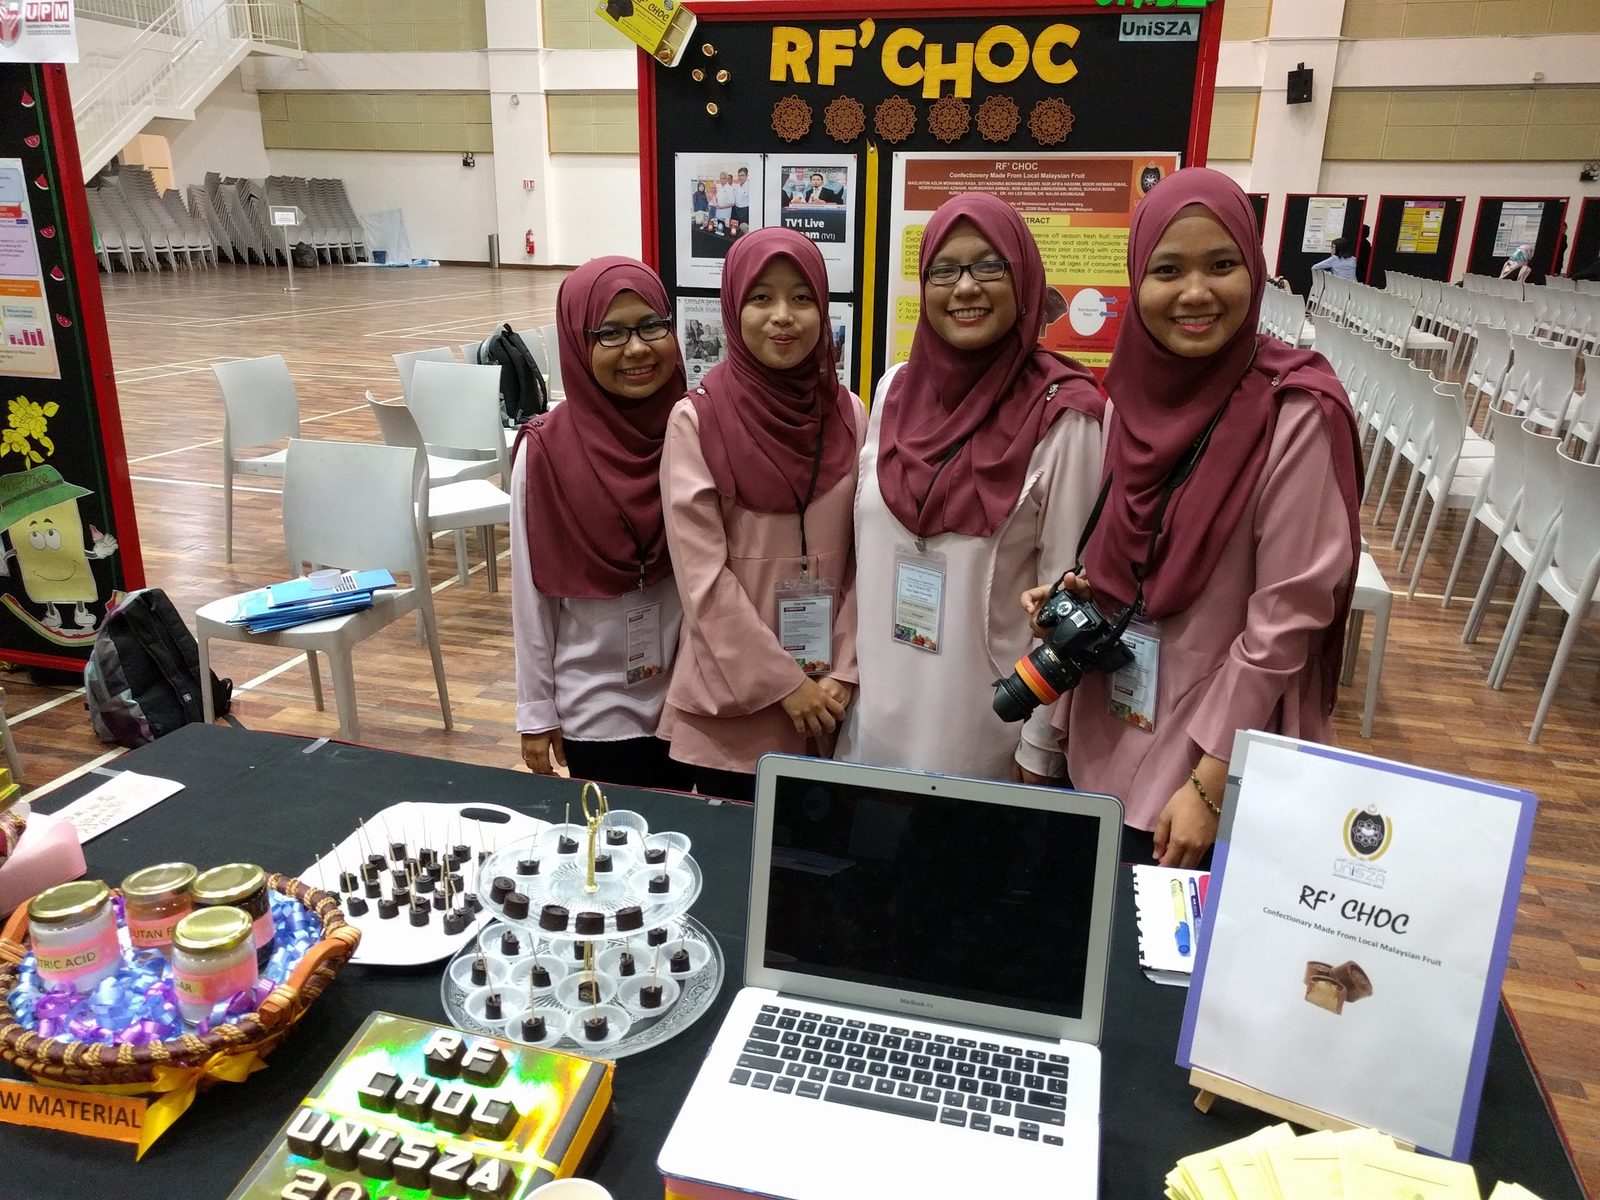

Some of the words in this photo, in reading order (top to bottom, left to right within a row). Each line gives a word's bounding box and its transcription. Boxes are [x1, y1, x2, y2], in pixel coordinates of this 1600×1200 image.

[26, 2, 69, 21] UPM
[648, 3, 670, 22] CHOC
[1122, 21, 1191, 36] UniSZA
[881, 23, 1081, 99] CHOC
[995, 162, 1010, 170] RF'
[1012, 162, 1039, 170] CHOC
[785, 218, 802, 228] TV1
[805, 218, 825, 228] Live
[1299, 884, 1336, 911] RF'
[1341, 899, 1410, 935] CHOC
[1262, 906, 1312, 928] Confectionary
[1314, 924, 1336, 935] Made
[1336, 930, 1357, 942] From
[1358, 937, 1379, 948] Local
[1380, 943, 1421, 961] Malaysian
[1422, 956, 1442, 968] Fruit
[38, 957, 62, 970] TRIC
[65, 952, 96, 968] ACID
[423, 1029, 501, 1067] RF
[28, 1094, 142, 1129] MATERIAL
[360, 1069, 513, 1125] CHOC
[286, 1108, 502, 1191] UNISZA
